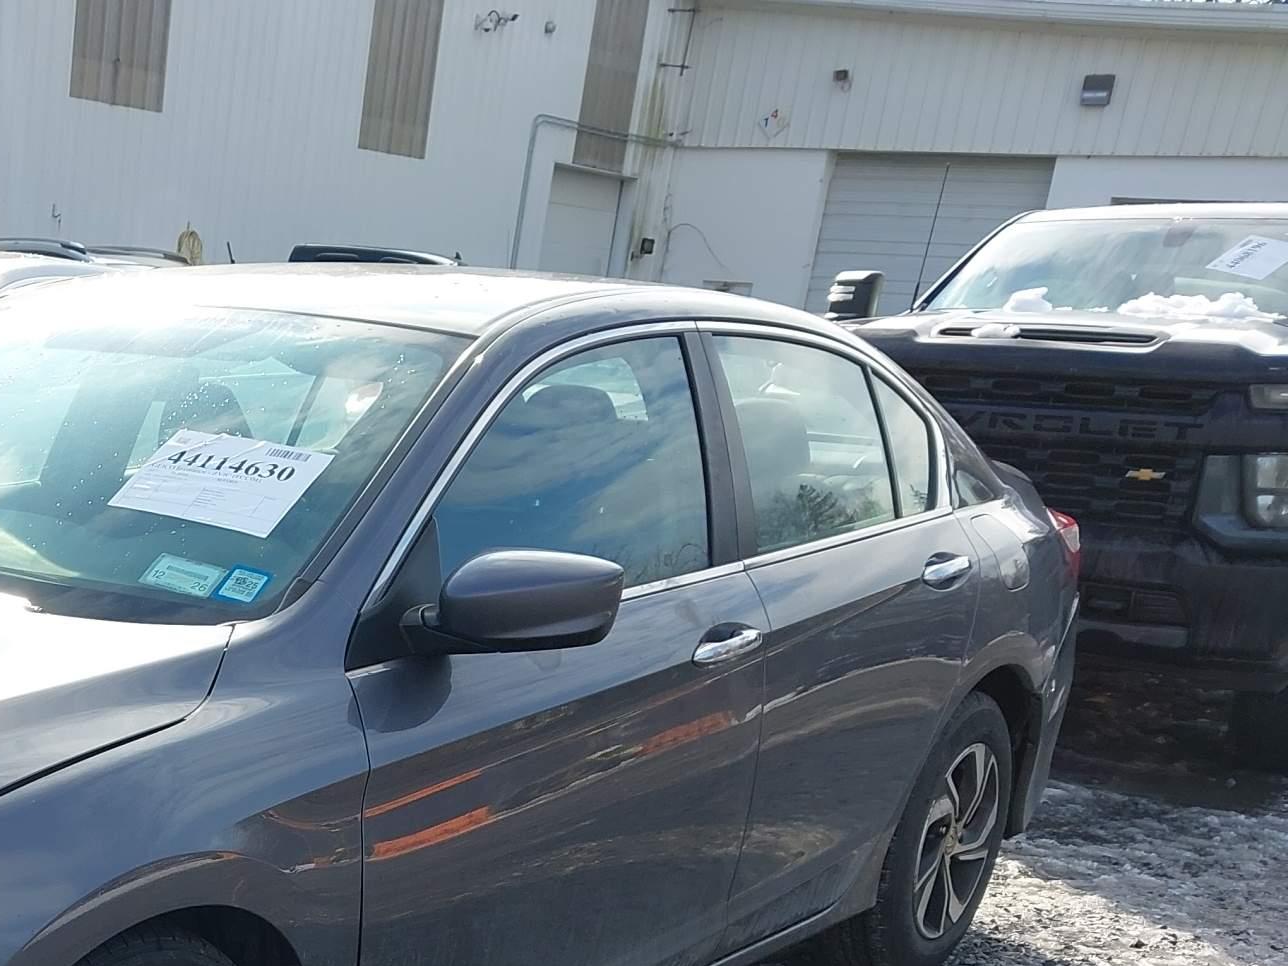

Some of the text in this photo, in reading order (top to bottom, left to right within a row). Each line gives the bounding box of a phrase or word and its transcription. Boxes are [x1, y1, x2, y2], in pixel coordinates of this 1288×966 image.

[167, 449, 296, 482] 44114630
[151, 569, 166, 580] 12
[190, 581, 209, 592] 26
